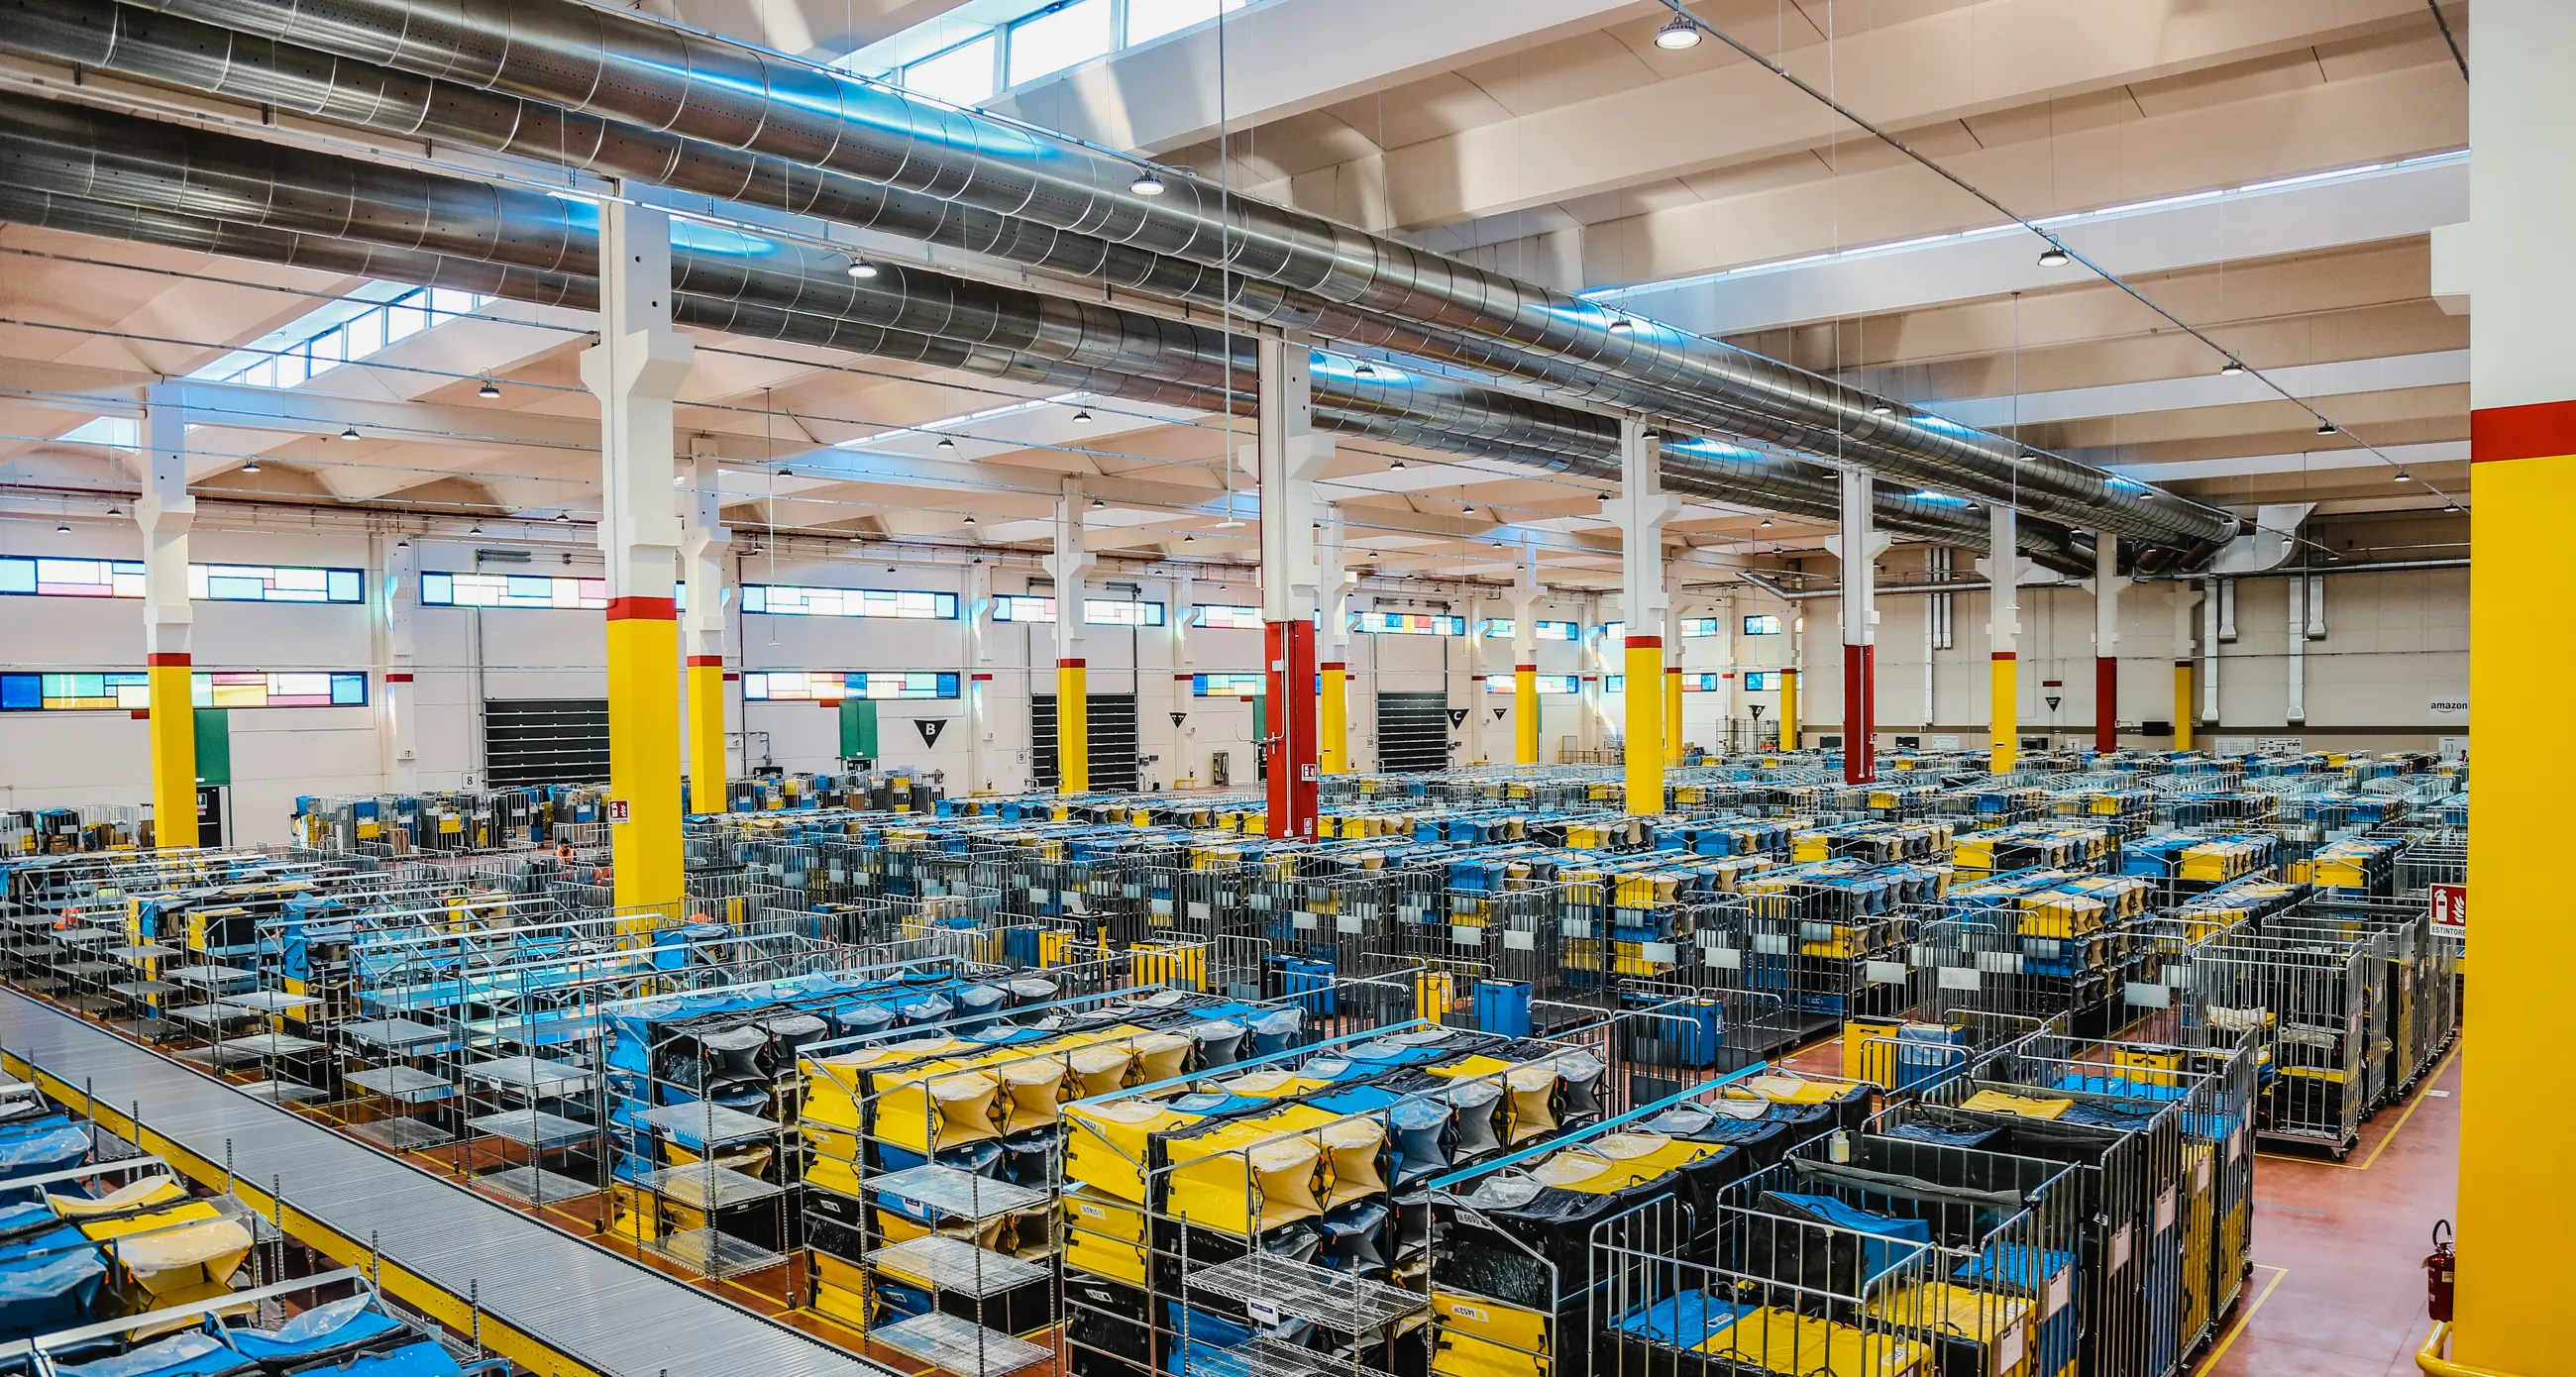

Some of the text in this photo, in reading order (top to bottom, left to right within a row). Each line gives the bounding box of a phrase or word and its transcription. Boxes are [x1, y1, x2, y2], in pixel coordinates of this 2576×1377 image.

[1453, 711, 1461, 720] C
[925, 723, 936, 735] B
[467, 776, 474, 785] 8
[2431, 926, 2466, 936] ESTINTORE
